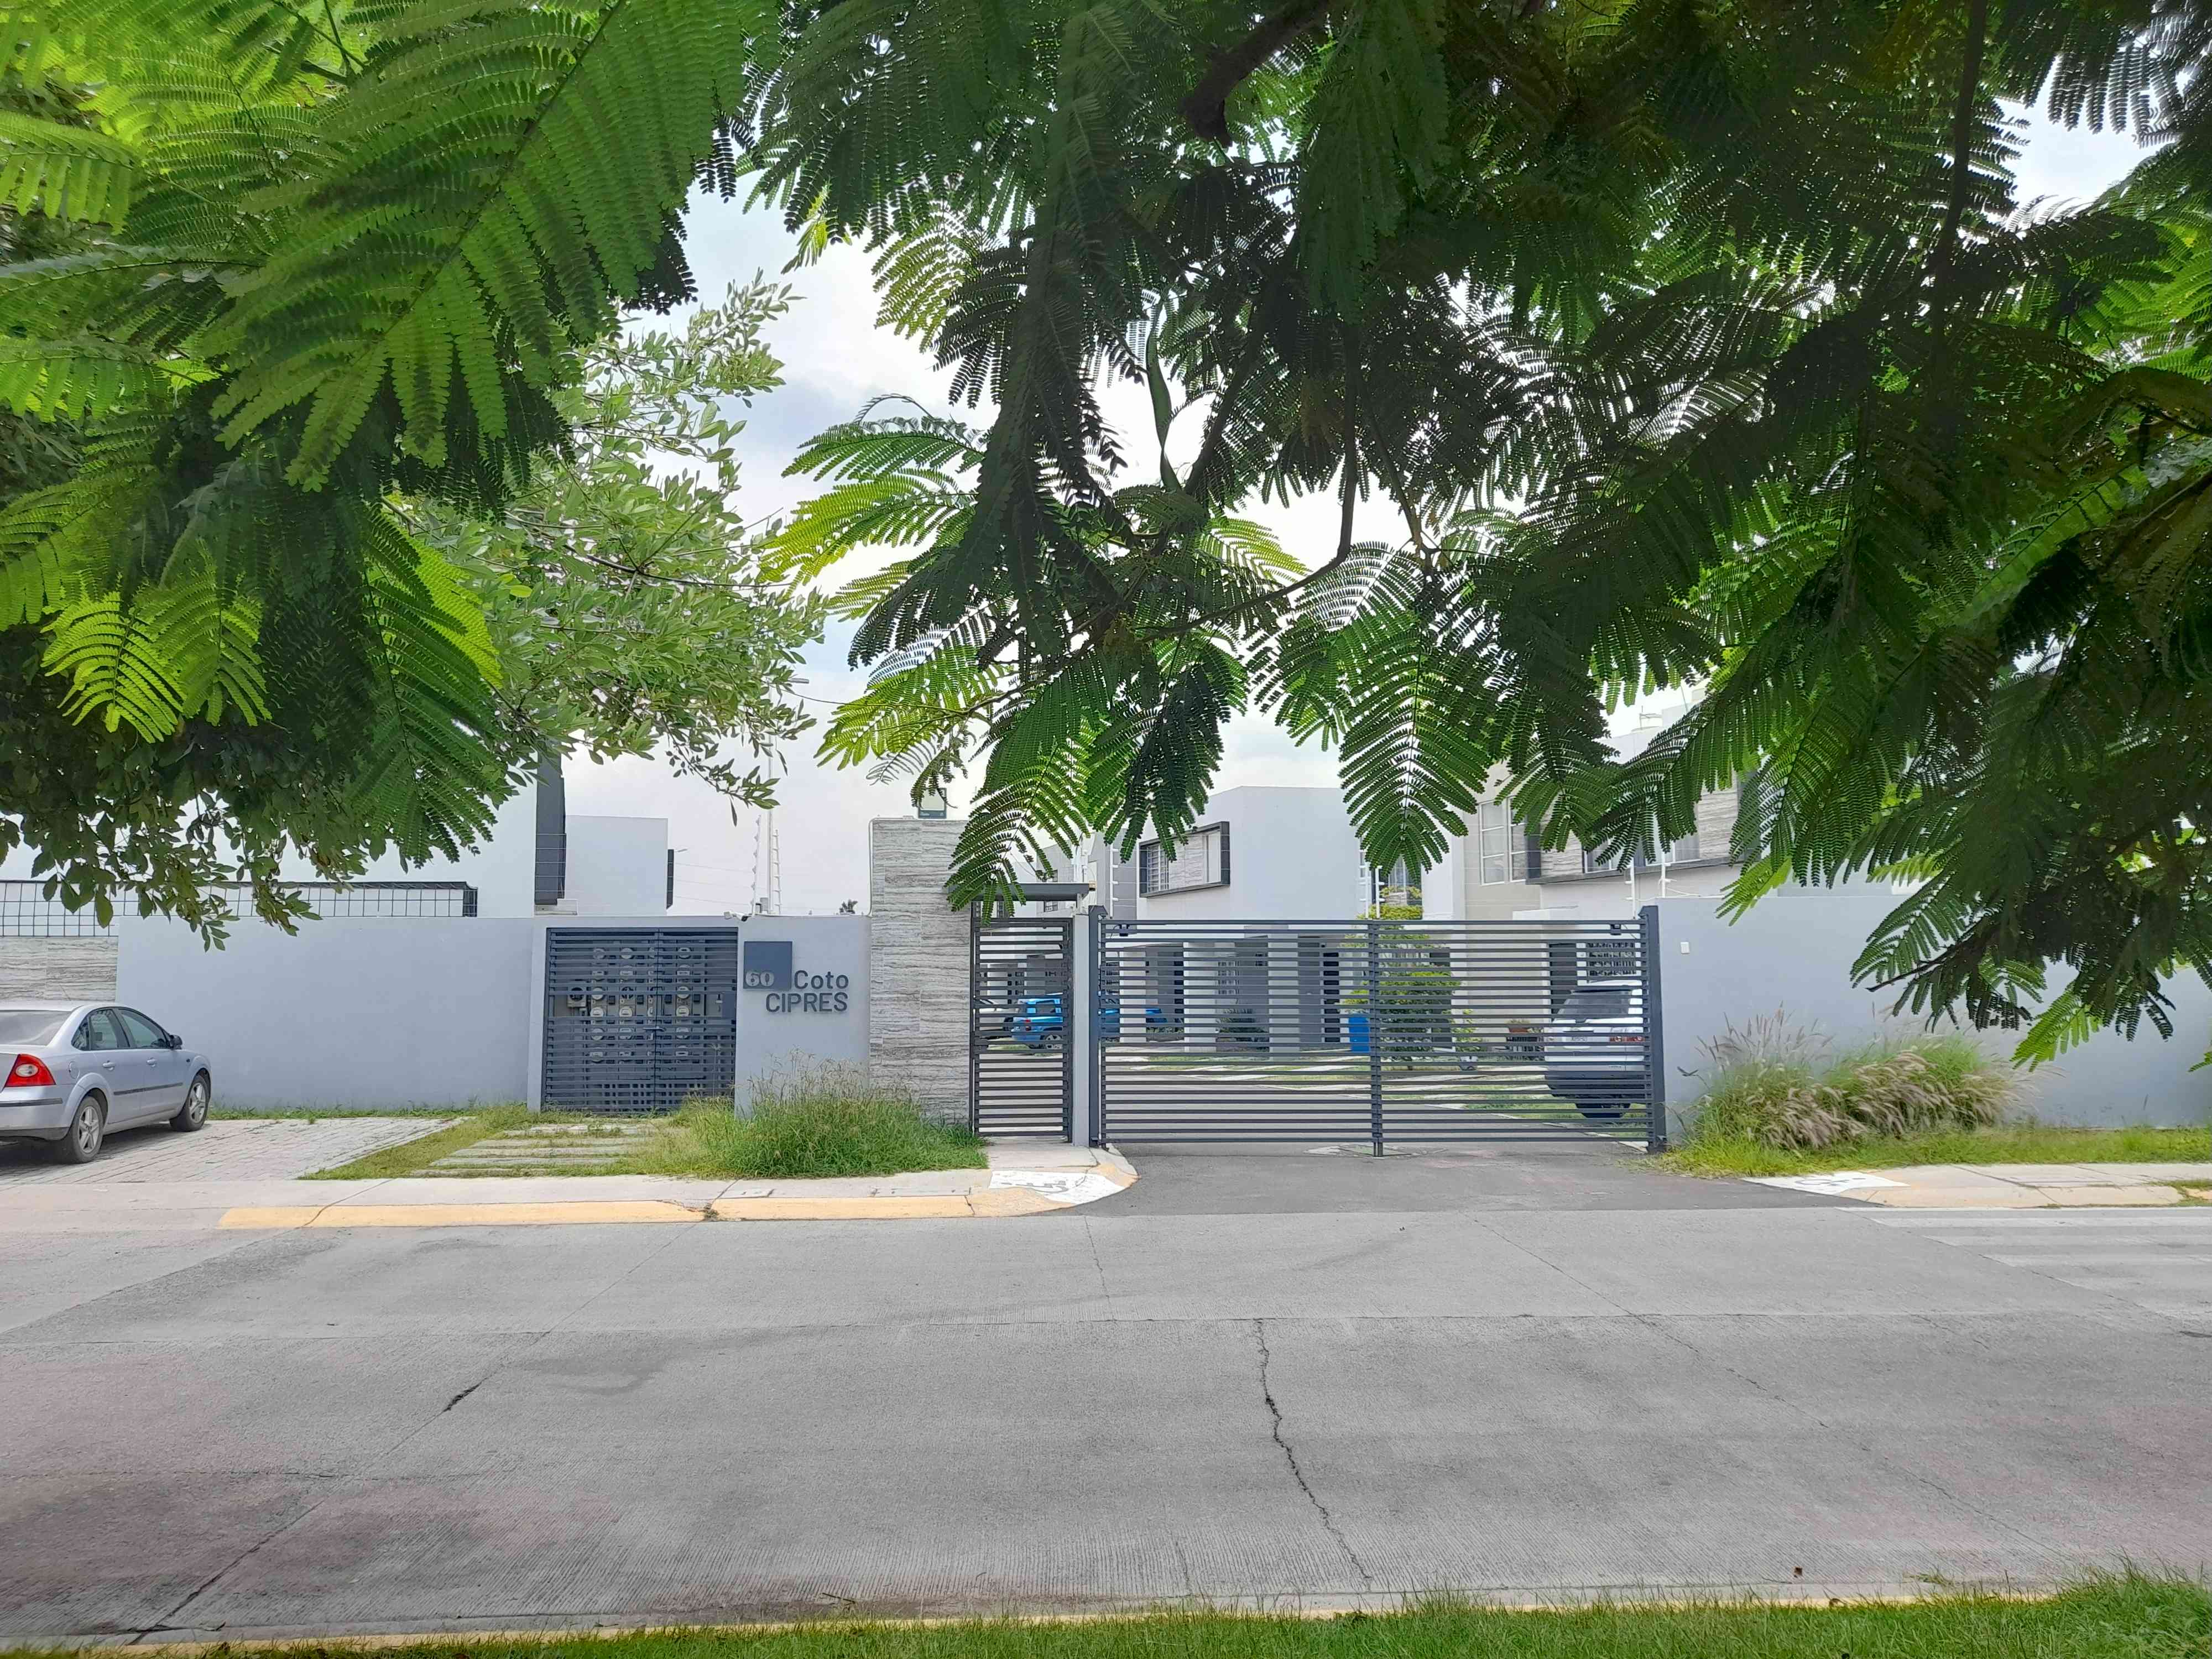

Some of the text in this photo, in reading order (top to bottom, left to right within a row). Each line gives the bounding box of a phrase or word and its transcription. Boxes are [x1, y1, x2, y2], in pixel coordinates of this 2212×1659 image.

[745, 971, 774, 987] 60
[794, 969, 849, 989] Coto
[766, 992, 848, 1013] CIPRES
